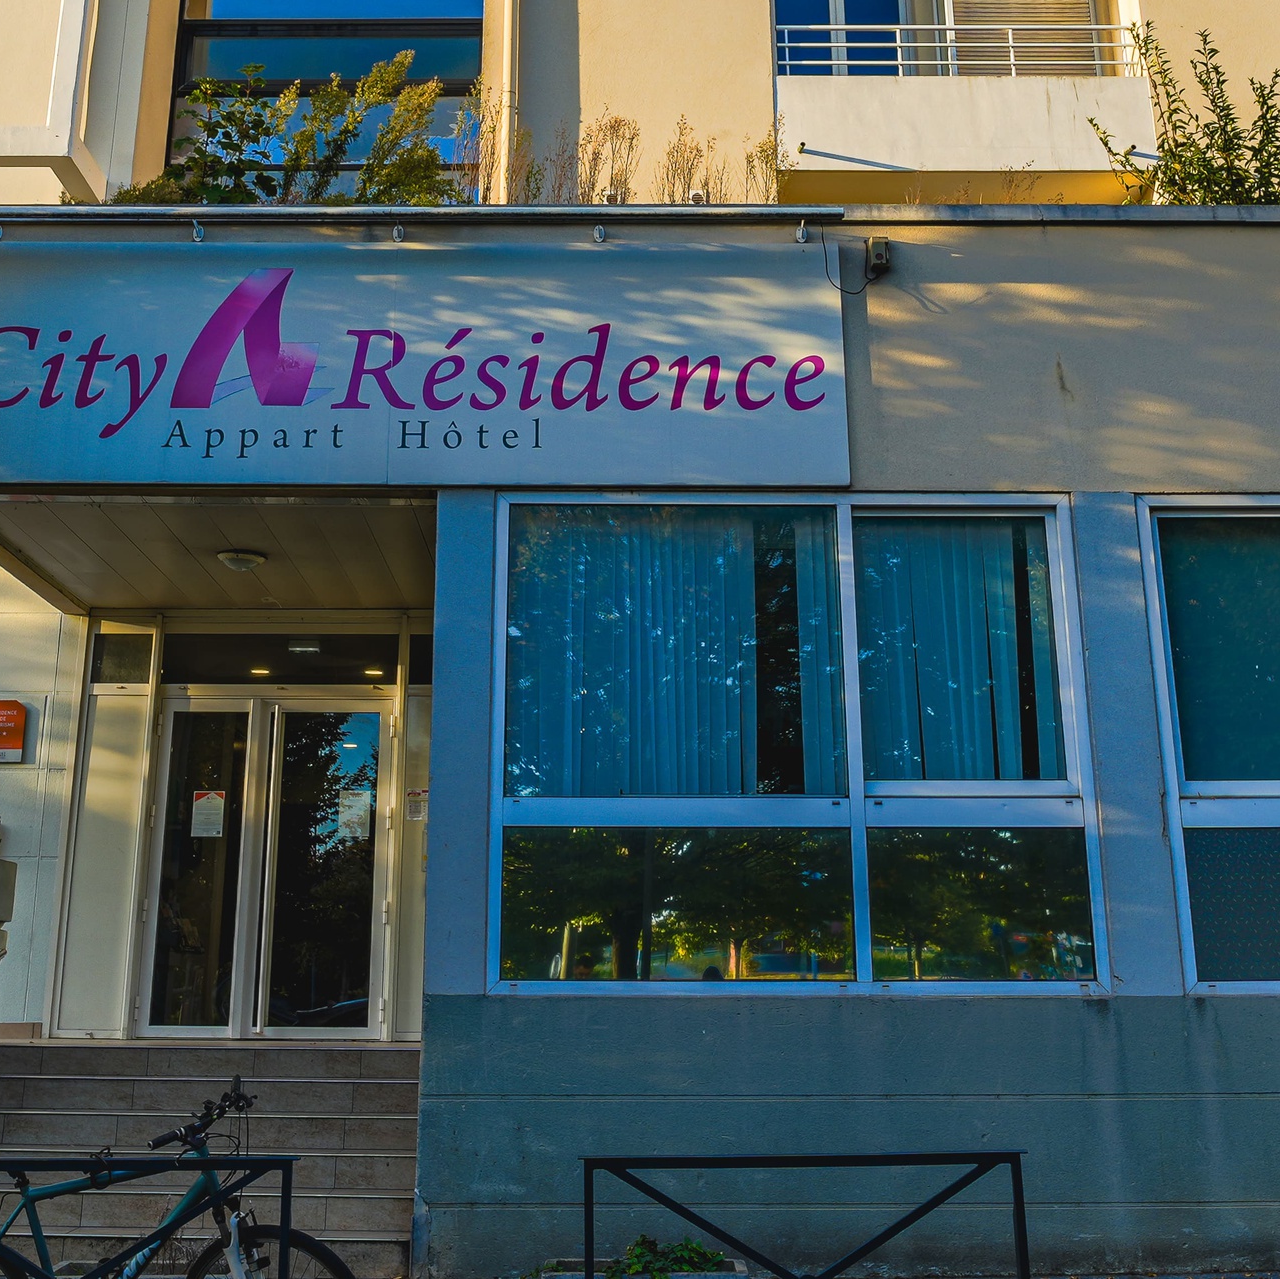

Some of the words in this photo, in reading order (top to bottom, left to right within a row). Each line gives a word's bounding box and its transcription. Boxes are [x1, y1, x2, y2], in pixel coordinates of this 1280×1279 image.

[330, 322, 827, 412] Résidence
[161, 419, 344, 459] Appart
[397, 418, 543, 450] Hôtel
